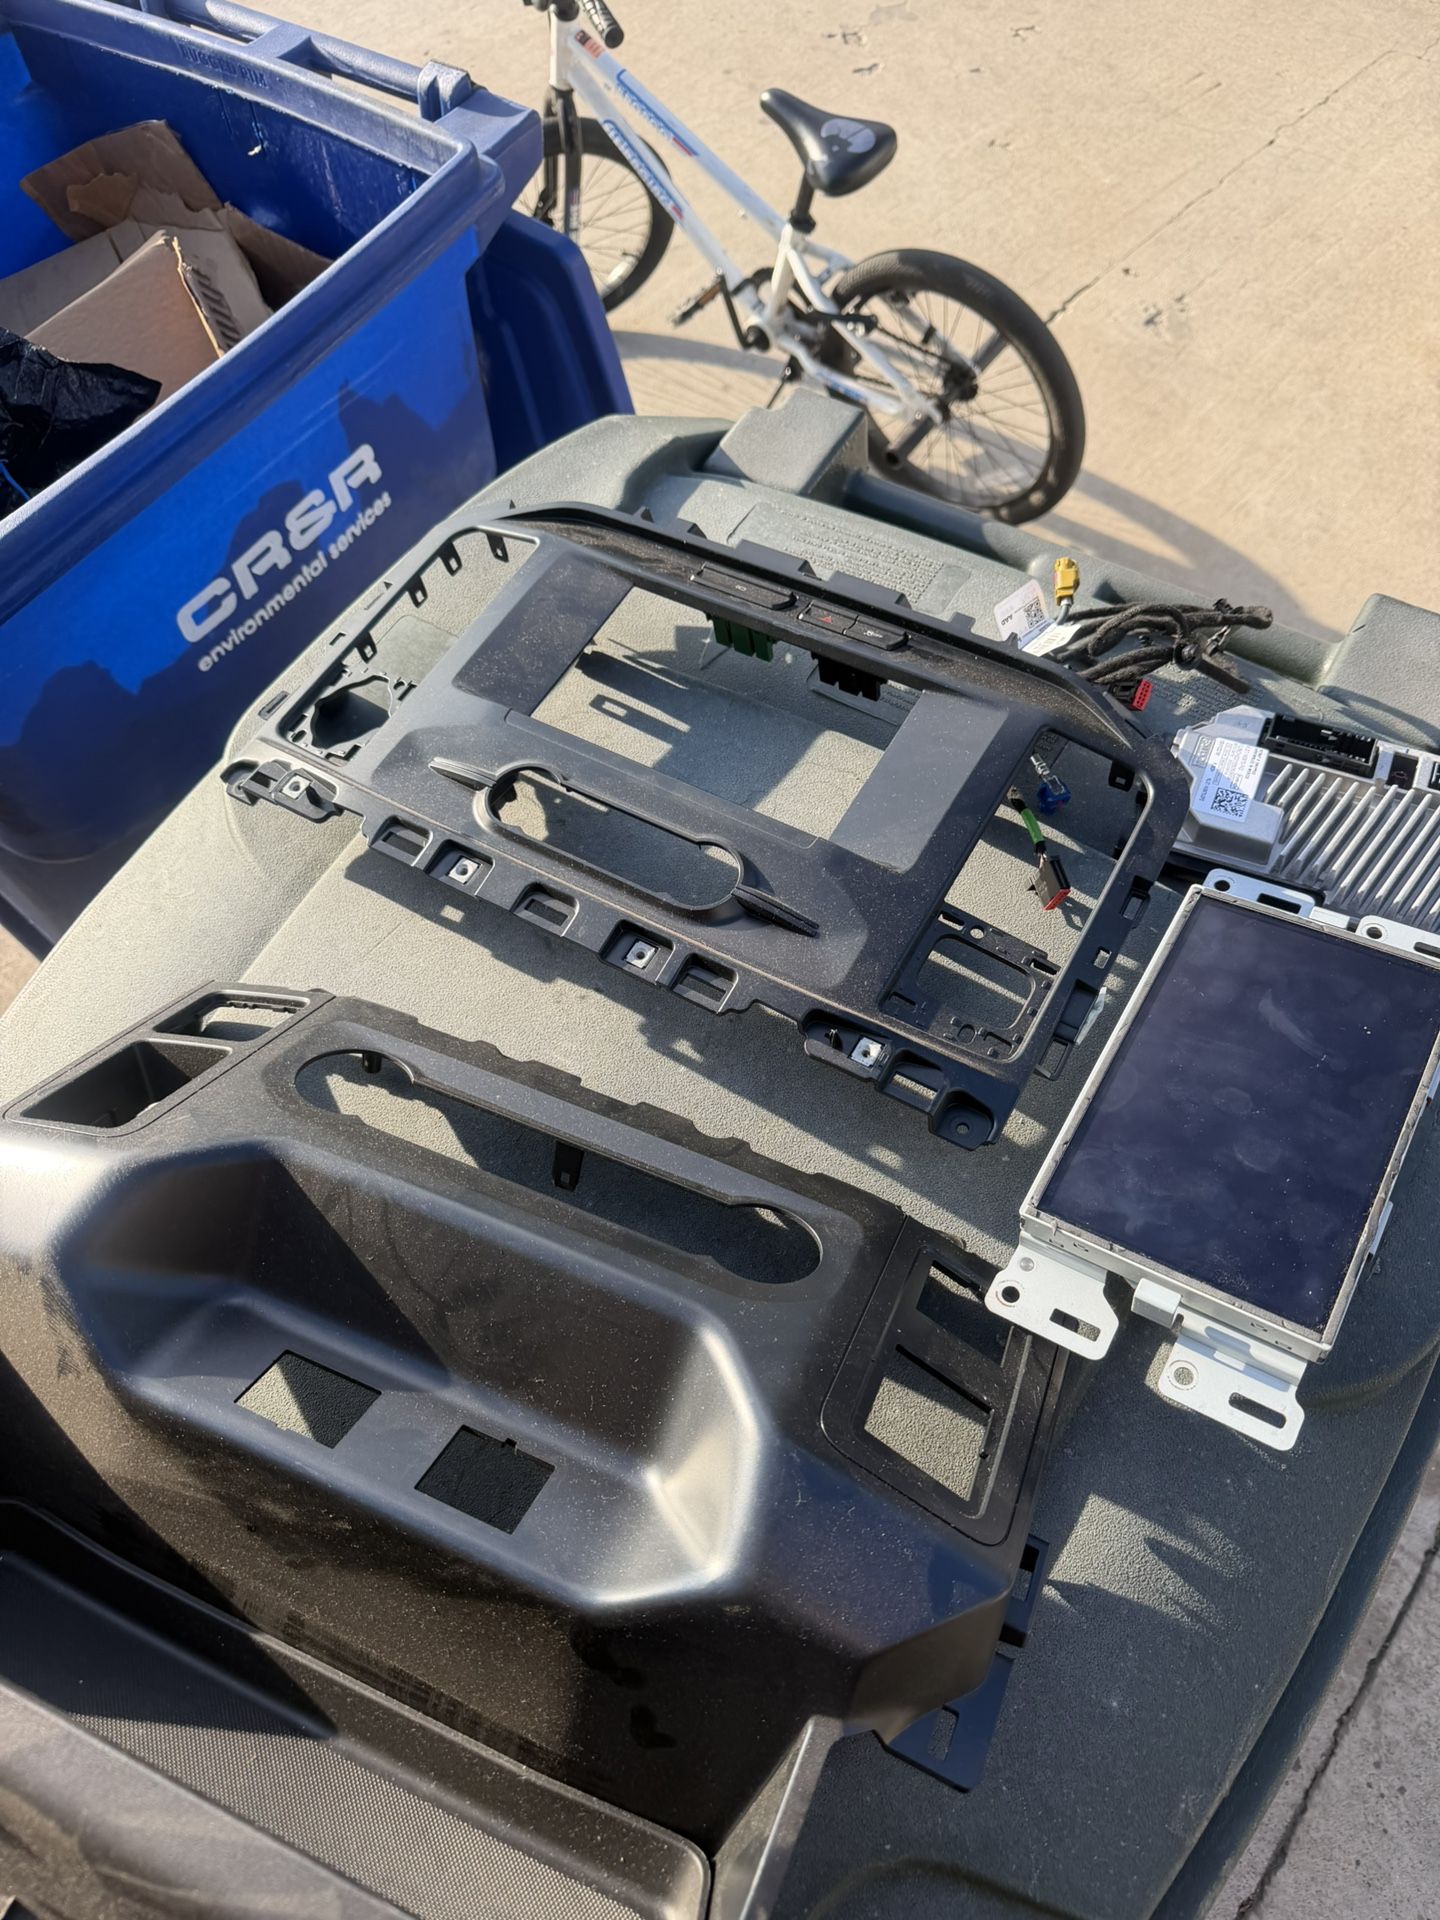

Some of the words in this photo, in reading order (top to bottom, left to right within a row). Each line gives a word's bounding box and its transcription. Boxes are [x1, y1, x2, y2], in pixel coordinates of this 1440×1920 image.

[176, 443, 383, 643] CR&R
[198, 552, 329, 672] environmental
[328, 491, 392, 560] services
